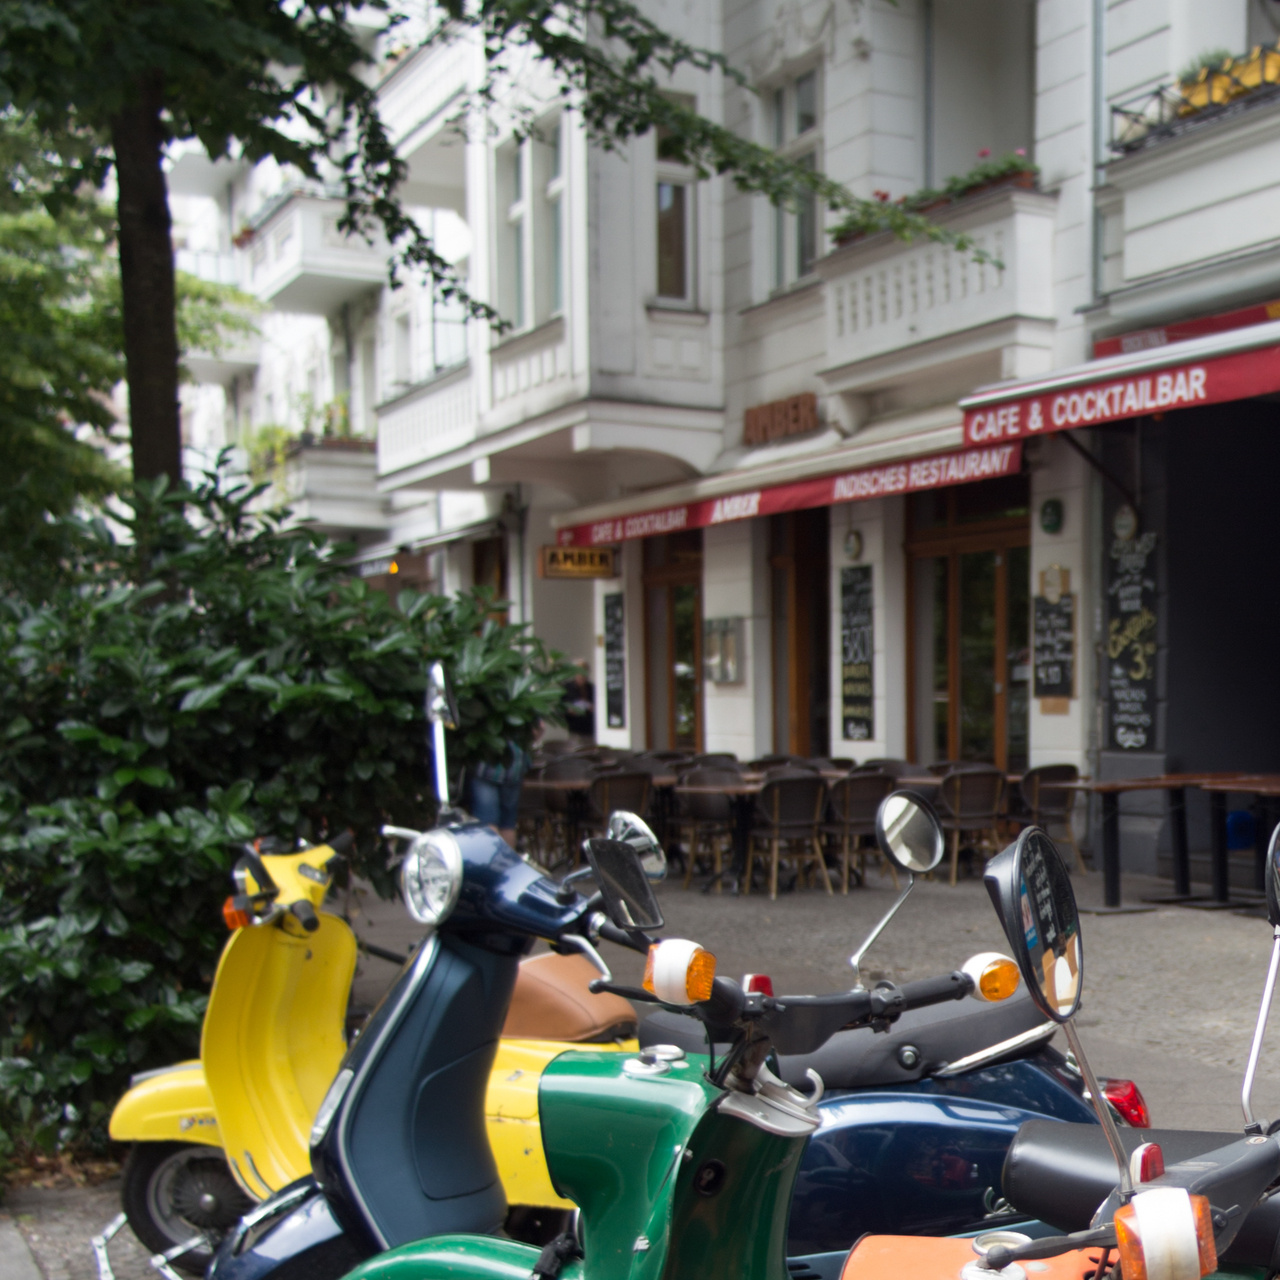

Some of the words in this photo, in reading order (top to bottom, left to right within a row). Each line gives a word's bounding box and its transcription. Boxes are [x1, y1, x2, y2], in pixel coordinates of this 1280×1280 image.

[970, 406, 1019, 442] CAFE
[1027, 401, 1043, 431] &
[1050, 368, 1206, 426] COCKTAILBAR
[834, 466, 906, 500] INDISCHES
[907, 446, 1014, 488] RESTAURANT
